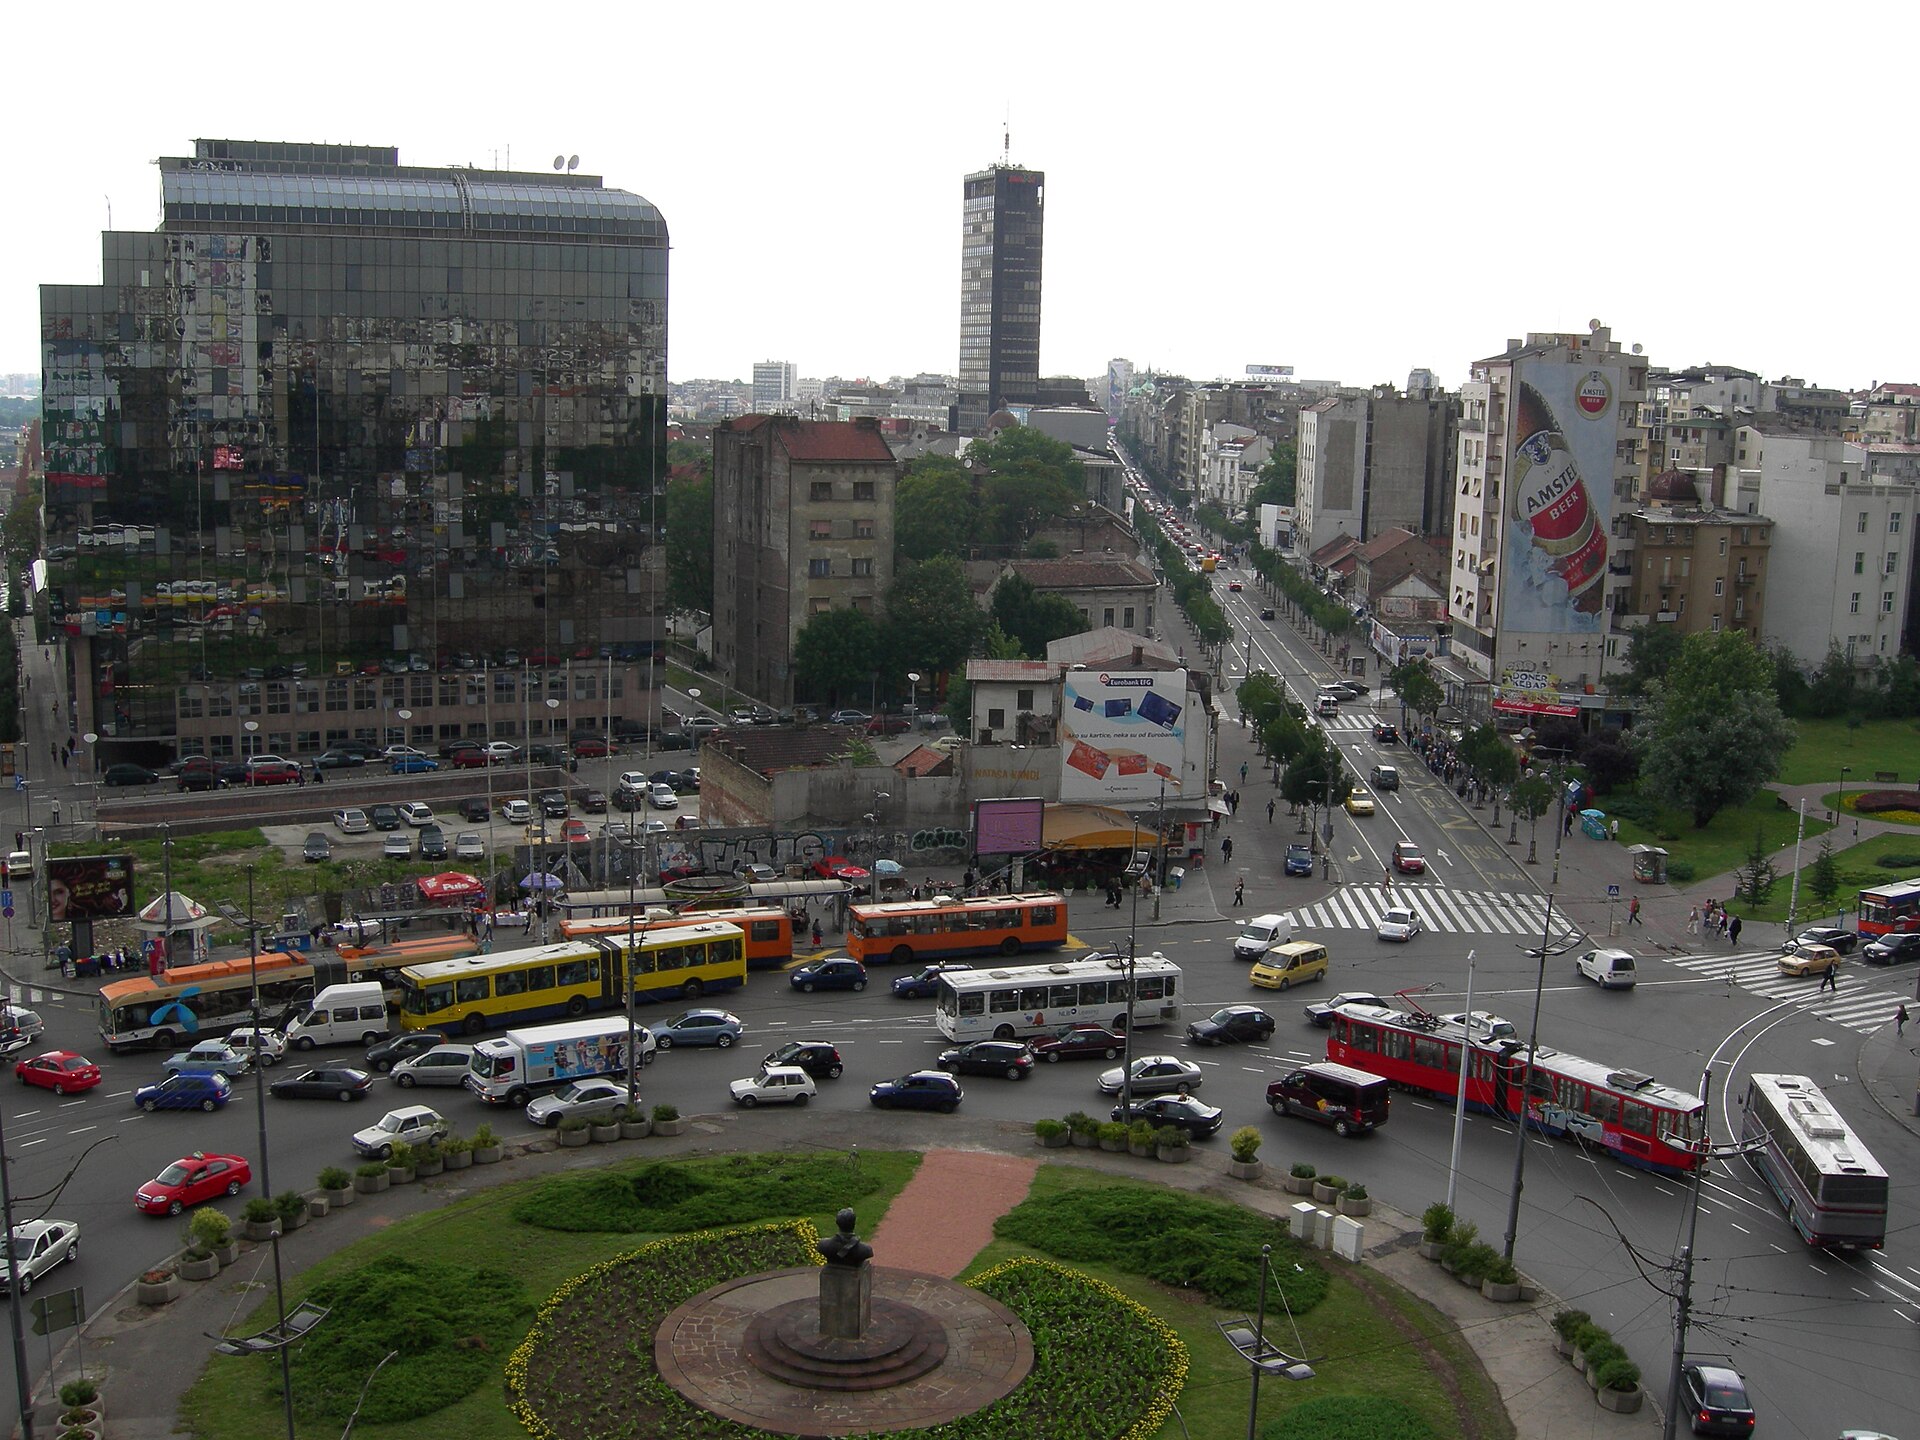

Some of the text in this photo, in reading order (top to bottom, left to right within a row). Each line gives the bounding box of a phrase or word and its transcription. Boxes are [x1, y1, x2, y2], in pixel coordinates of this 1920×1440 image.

[1583, 388, 1605, 396] AMSTEL
[1526, 463, 1577, 513] AMSTEL
[1549, 491, 1579, 520] BEER
[1395, 766, 1426, 777] BUS
[1421, 795, 1455, 809] BUS
[1463, 844, 1501, 860] BUS
